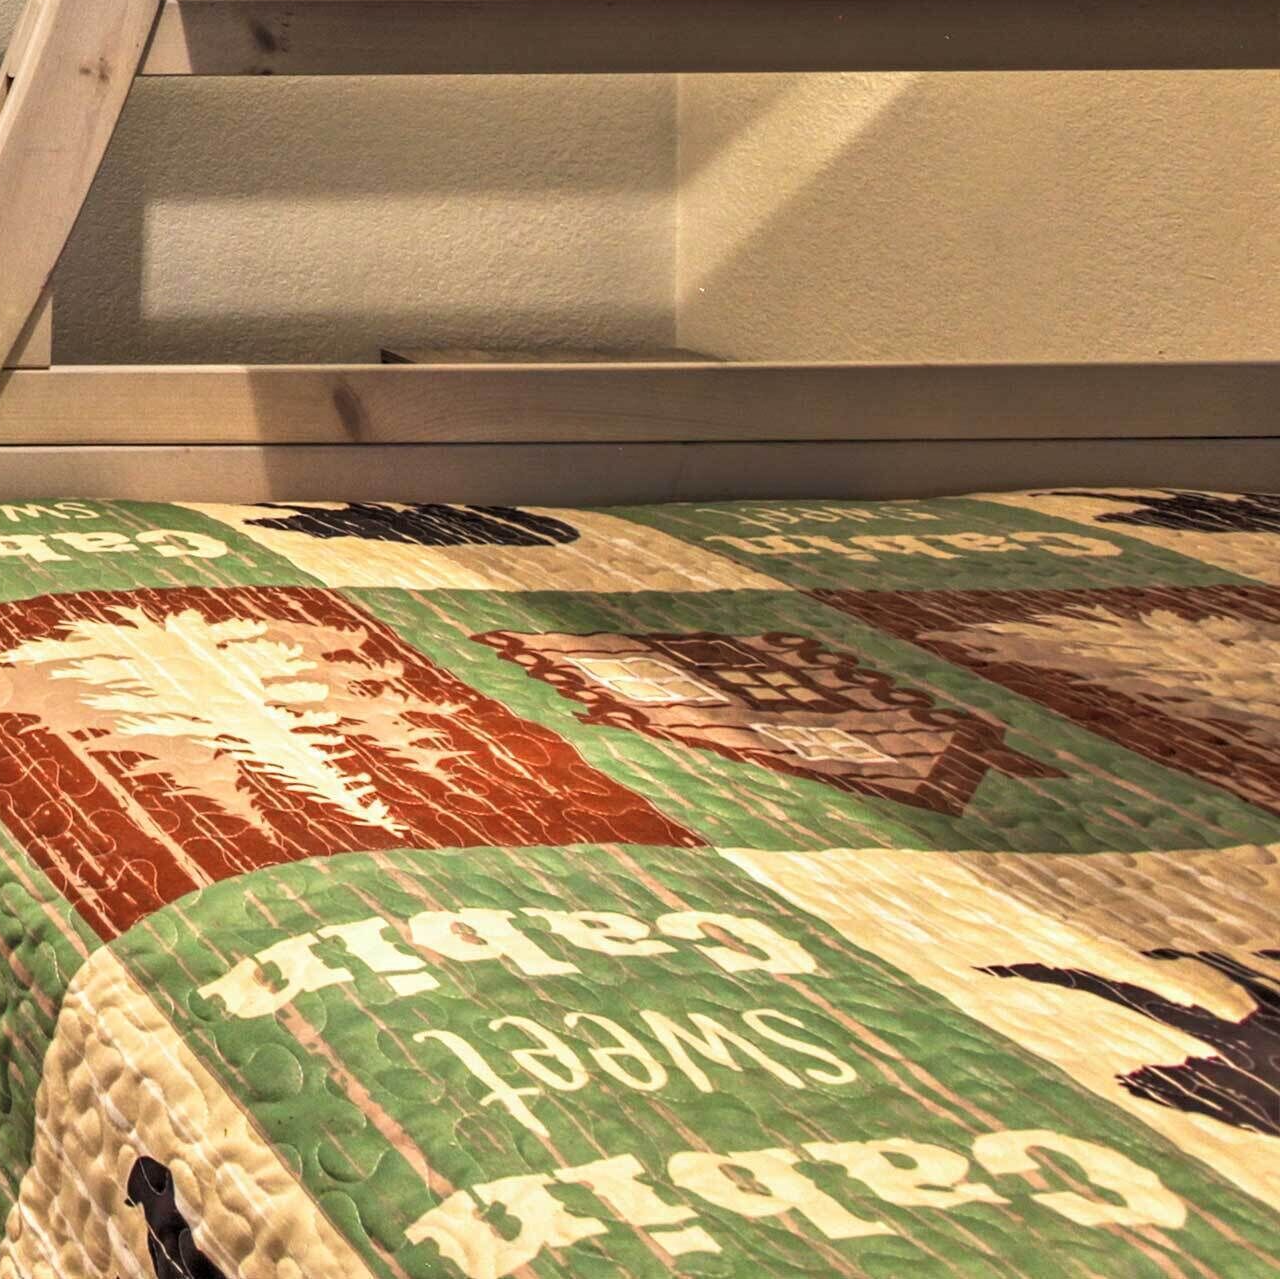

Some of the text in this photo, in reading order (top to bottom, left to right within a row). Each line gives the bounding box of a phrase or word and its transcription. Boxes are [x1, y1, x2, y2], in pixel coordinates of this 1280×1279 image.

[705, 530, 1123, 561] Cabin
[196, 907, 819, 1019] Cabin
[405, 1128, 1188, 1279] Cabin
